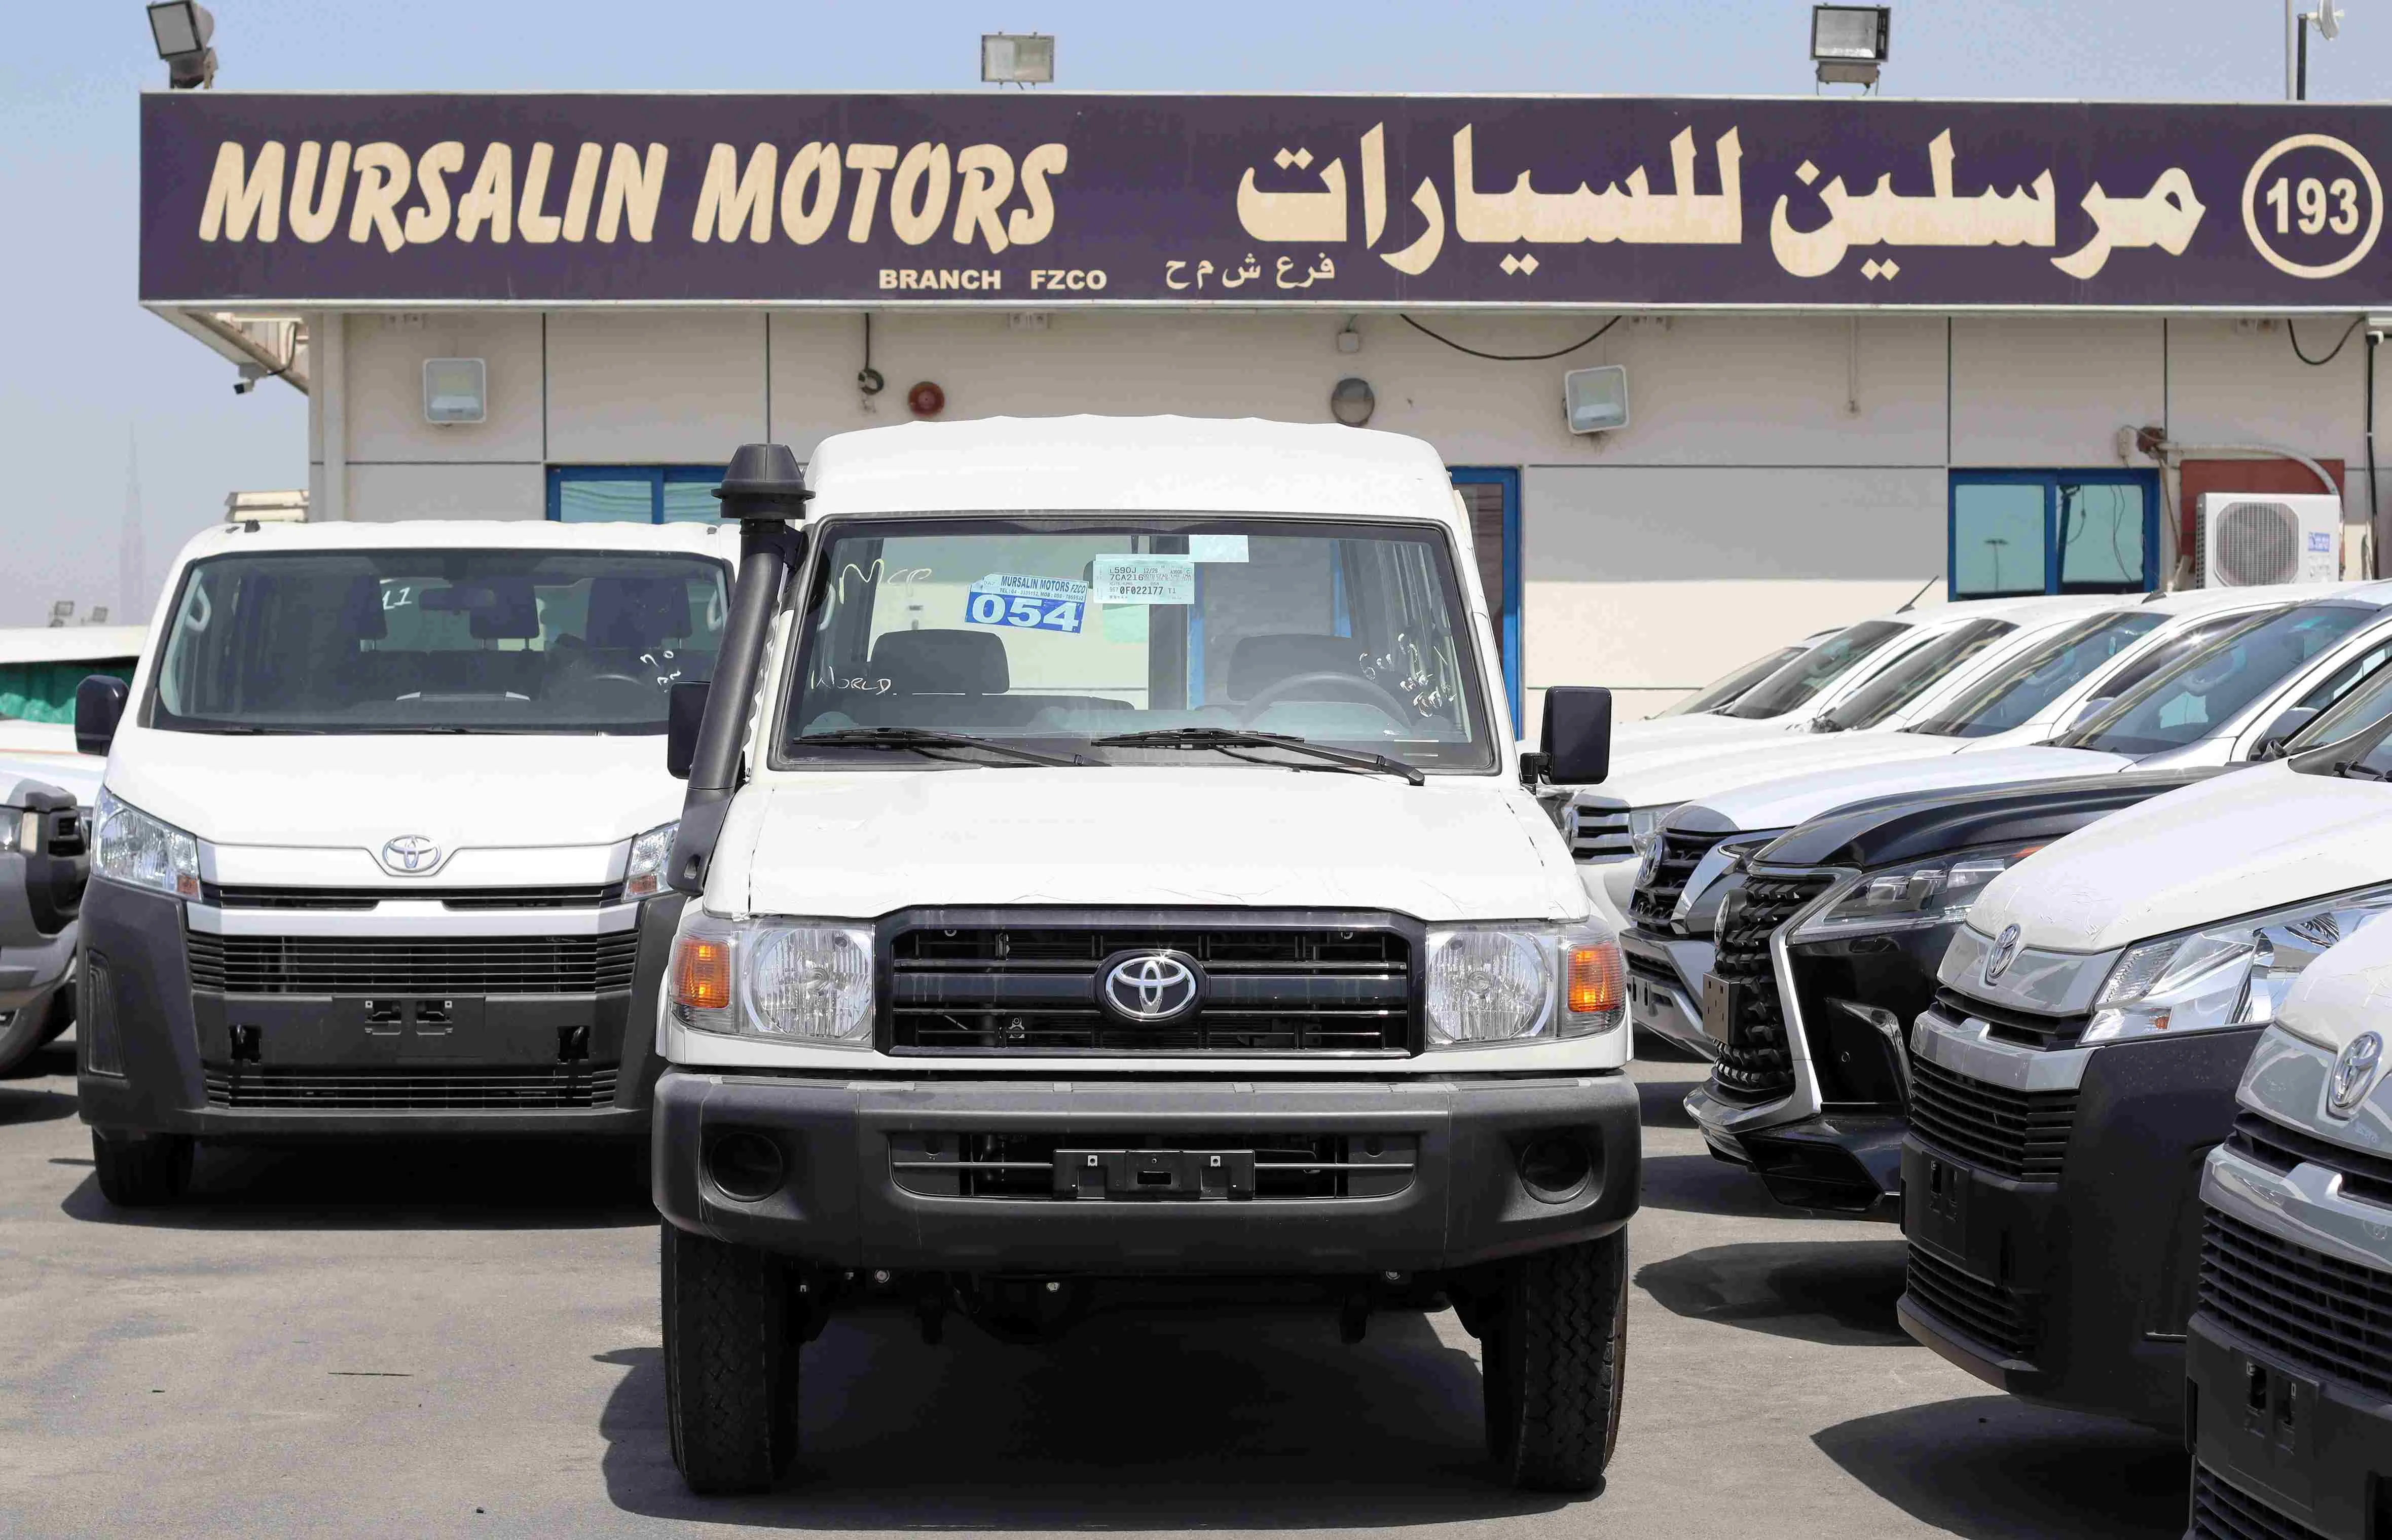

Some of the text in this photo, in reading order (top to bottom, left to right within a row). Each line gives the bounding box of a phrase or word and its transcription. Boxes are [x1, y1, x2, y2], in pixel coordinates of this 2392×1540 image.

[199, 141, 1068, 254] MURSALIN MOTORS
[1236, 122, 2206, 280] مرسلين للسيارات
[2266, 177, 2359, 235] 193
[878, 269, 1108, 290] BRANCH FZCO
[1276, 252, 1336, 289] فرع
[1001, 575, 1086, 594] MURSALIN MOTORS FZCO
[973, 594, 1079, 632] 054
